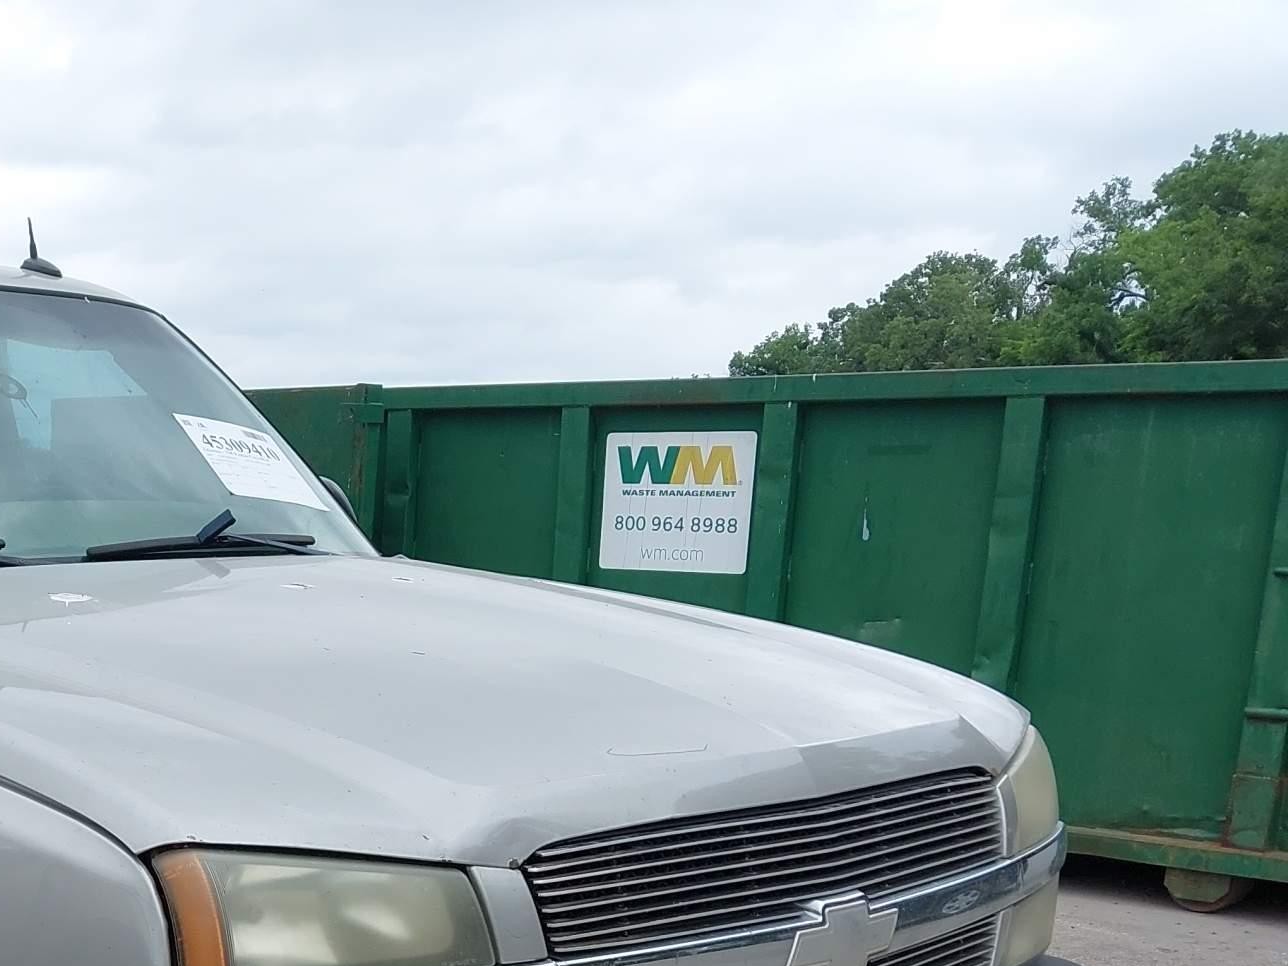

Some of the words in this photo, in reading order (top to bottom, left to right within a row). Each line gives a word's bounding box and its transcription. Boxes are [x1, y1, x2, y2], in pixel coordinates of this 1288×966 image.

[202, 433, 280, 461] 45309410
[618, 446, 737, 485] WM
[622, 489, 656, 497] WASTE
[658, 489, 737, 498] MANAGEMENT
[615, 516, 646, 531] 800
[651, 516, 684, 532] 964
[690, 517, 738, 534] 8988
[640, 546, 704, 562] wm.com
